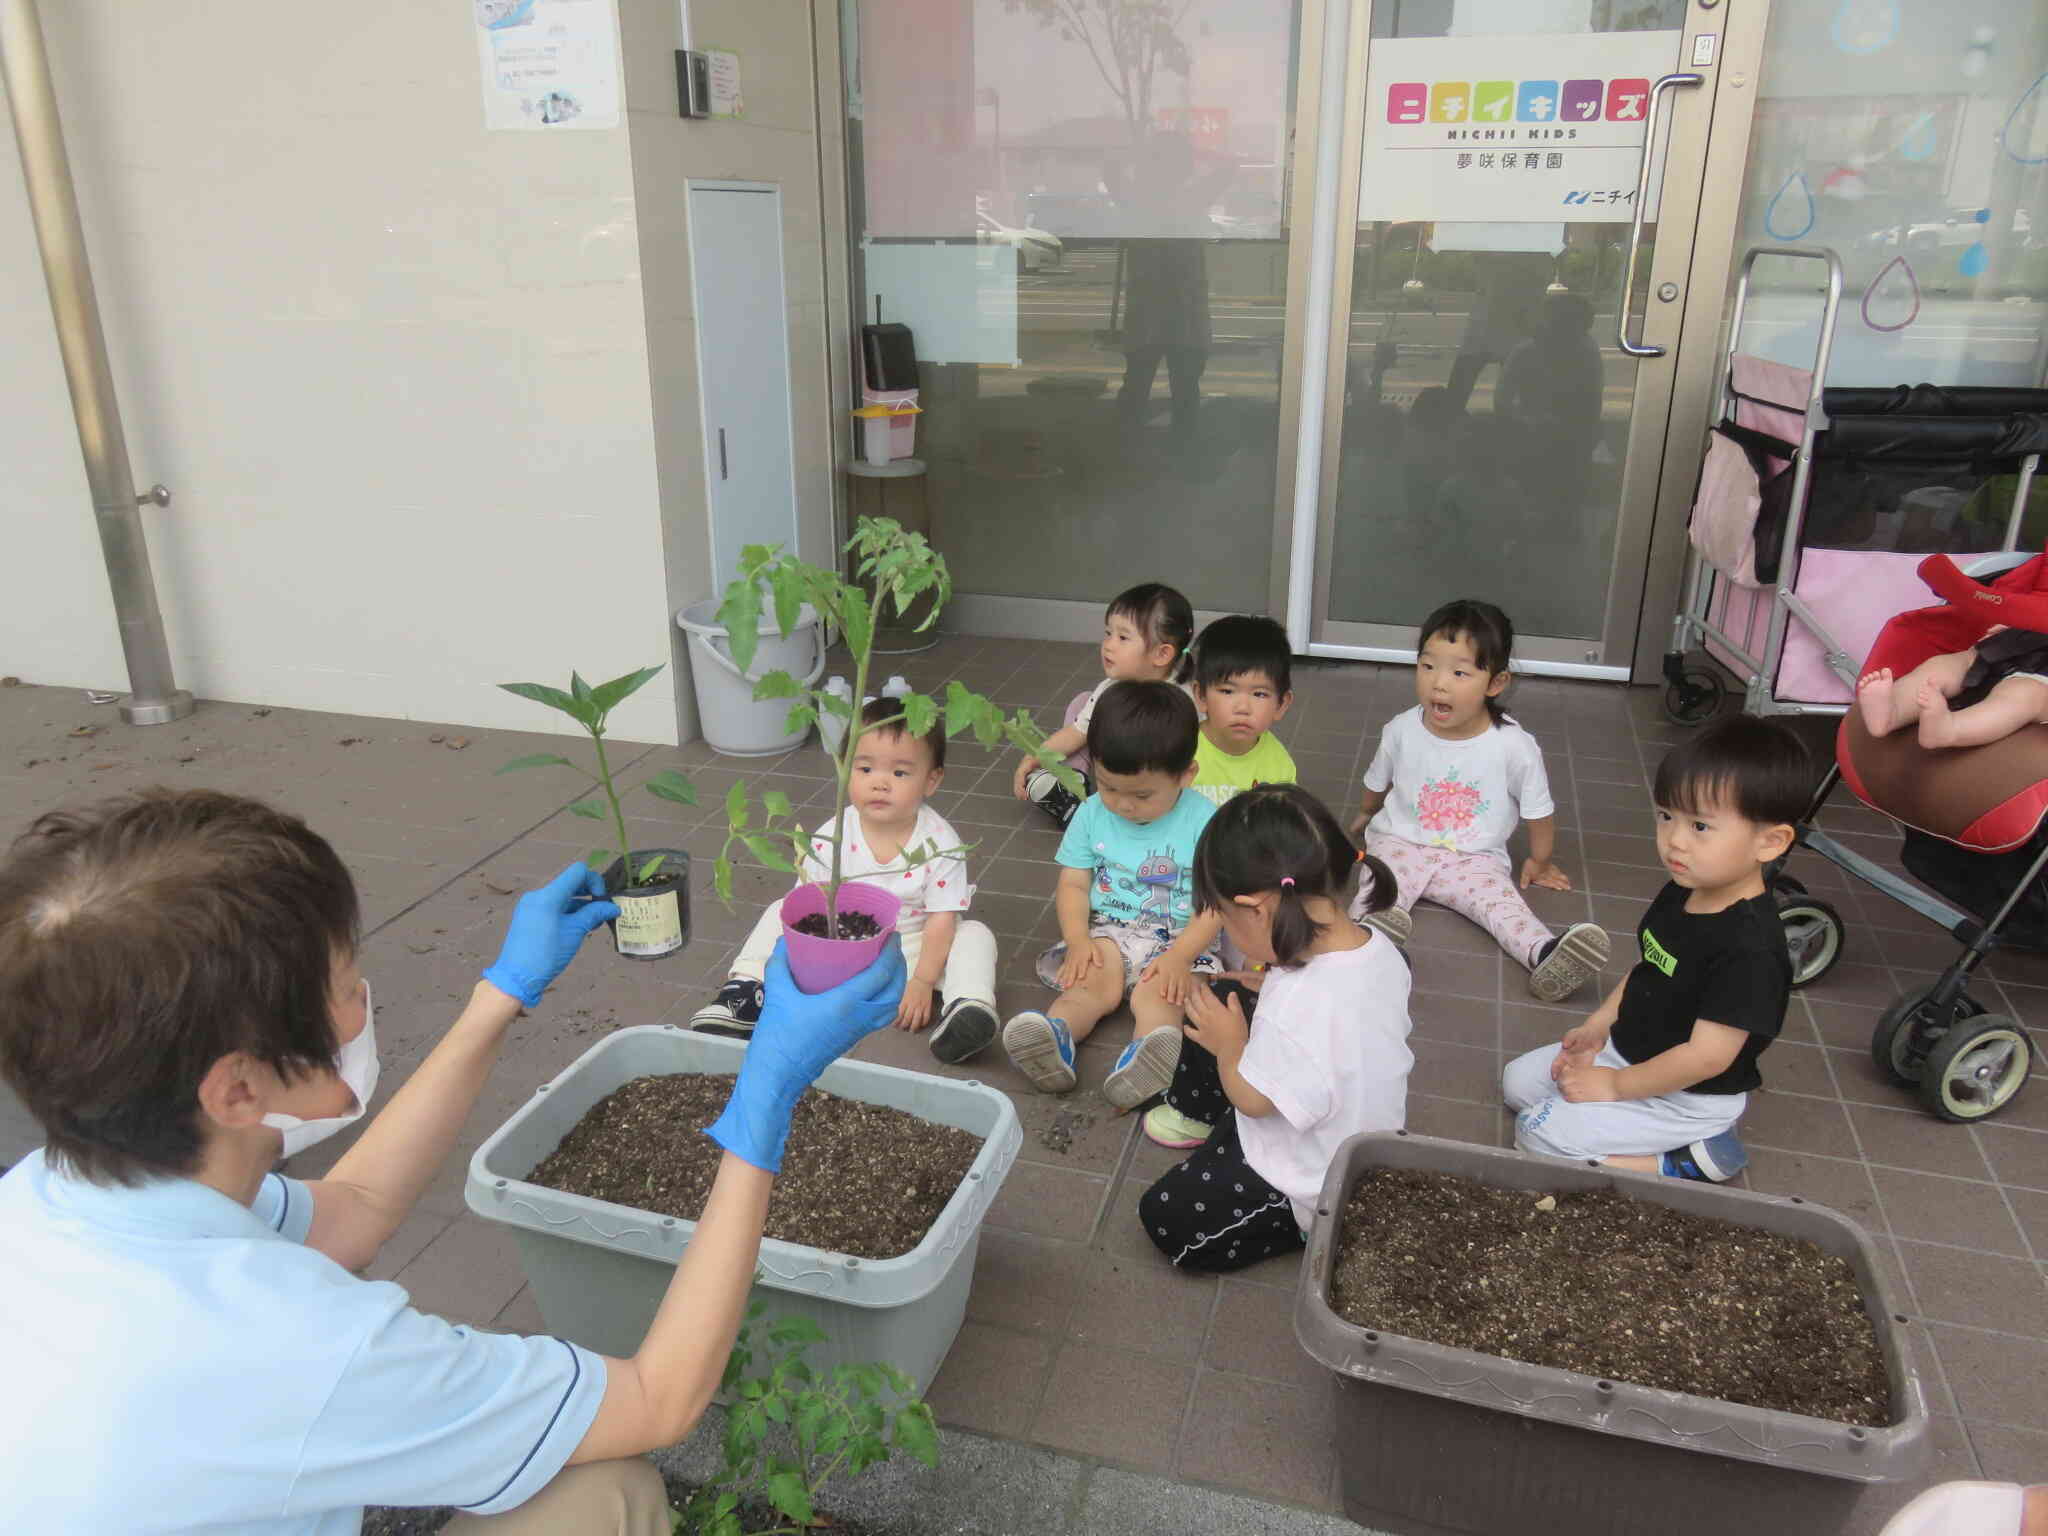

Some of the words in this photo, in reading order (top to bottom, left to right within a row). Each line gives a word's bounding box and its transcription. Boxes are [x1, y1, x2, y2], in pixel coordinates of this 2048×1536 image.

[1398, 92, 1647, 121] ニチイキッズ
[1447, 129, 1515, 140] NICHII
[1528, 128, 1577, 139] KIDS
[1456, 152, 1563, 169] 夢咲保育園
[1591, 190, 1637, 204] ニチイ
